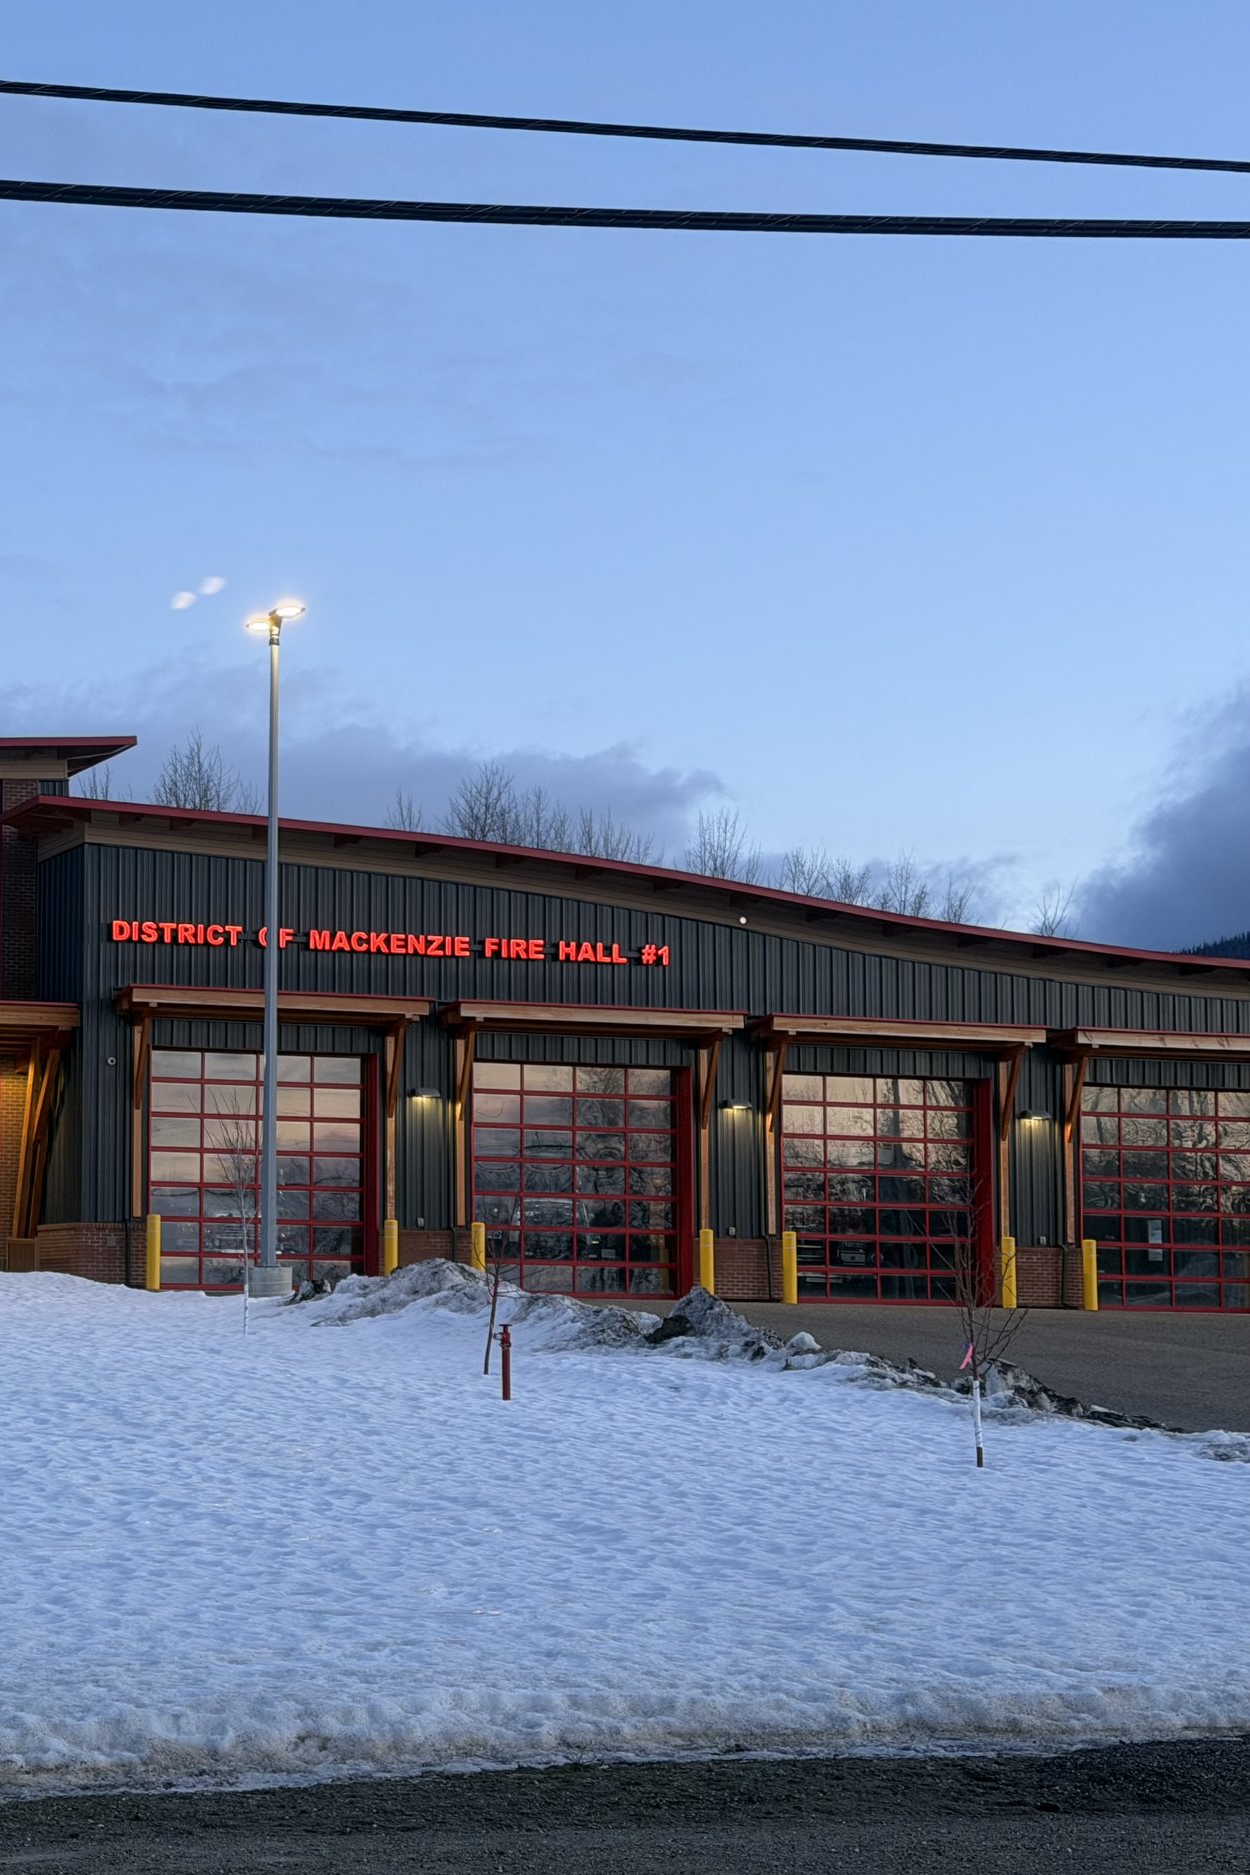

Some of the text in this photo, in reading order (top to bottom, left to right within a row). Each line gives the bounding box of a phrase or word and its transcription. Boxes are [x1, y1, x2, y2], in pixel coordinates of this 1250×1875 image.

[112, 920, 243, 946] DISTRICT
[309, 929, 471, 957] MACKENZIE
[485, 937, 545, 960] FIRE
[559, 940, 628, 964] HALL
[641, 944, 671, 966] #1
